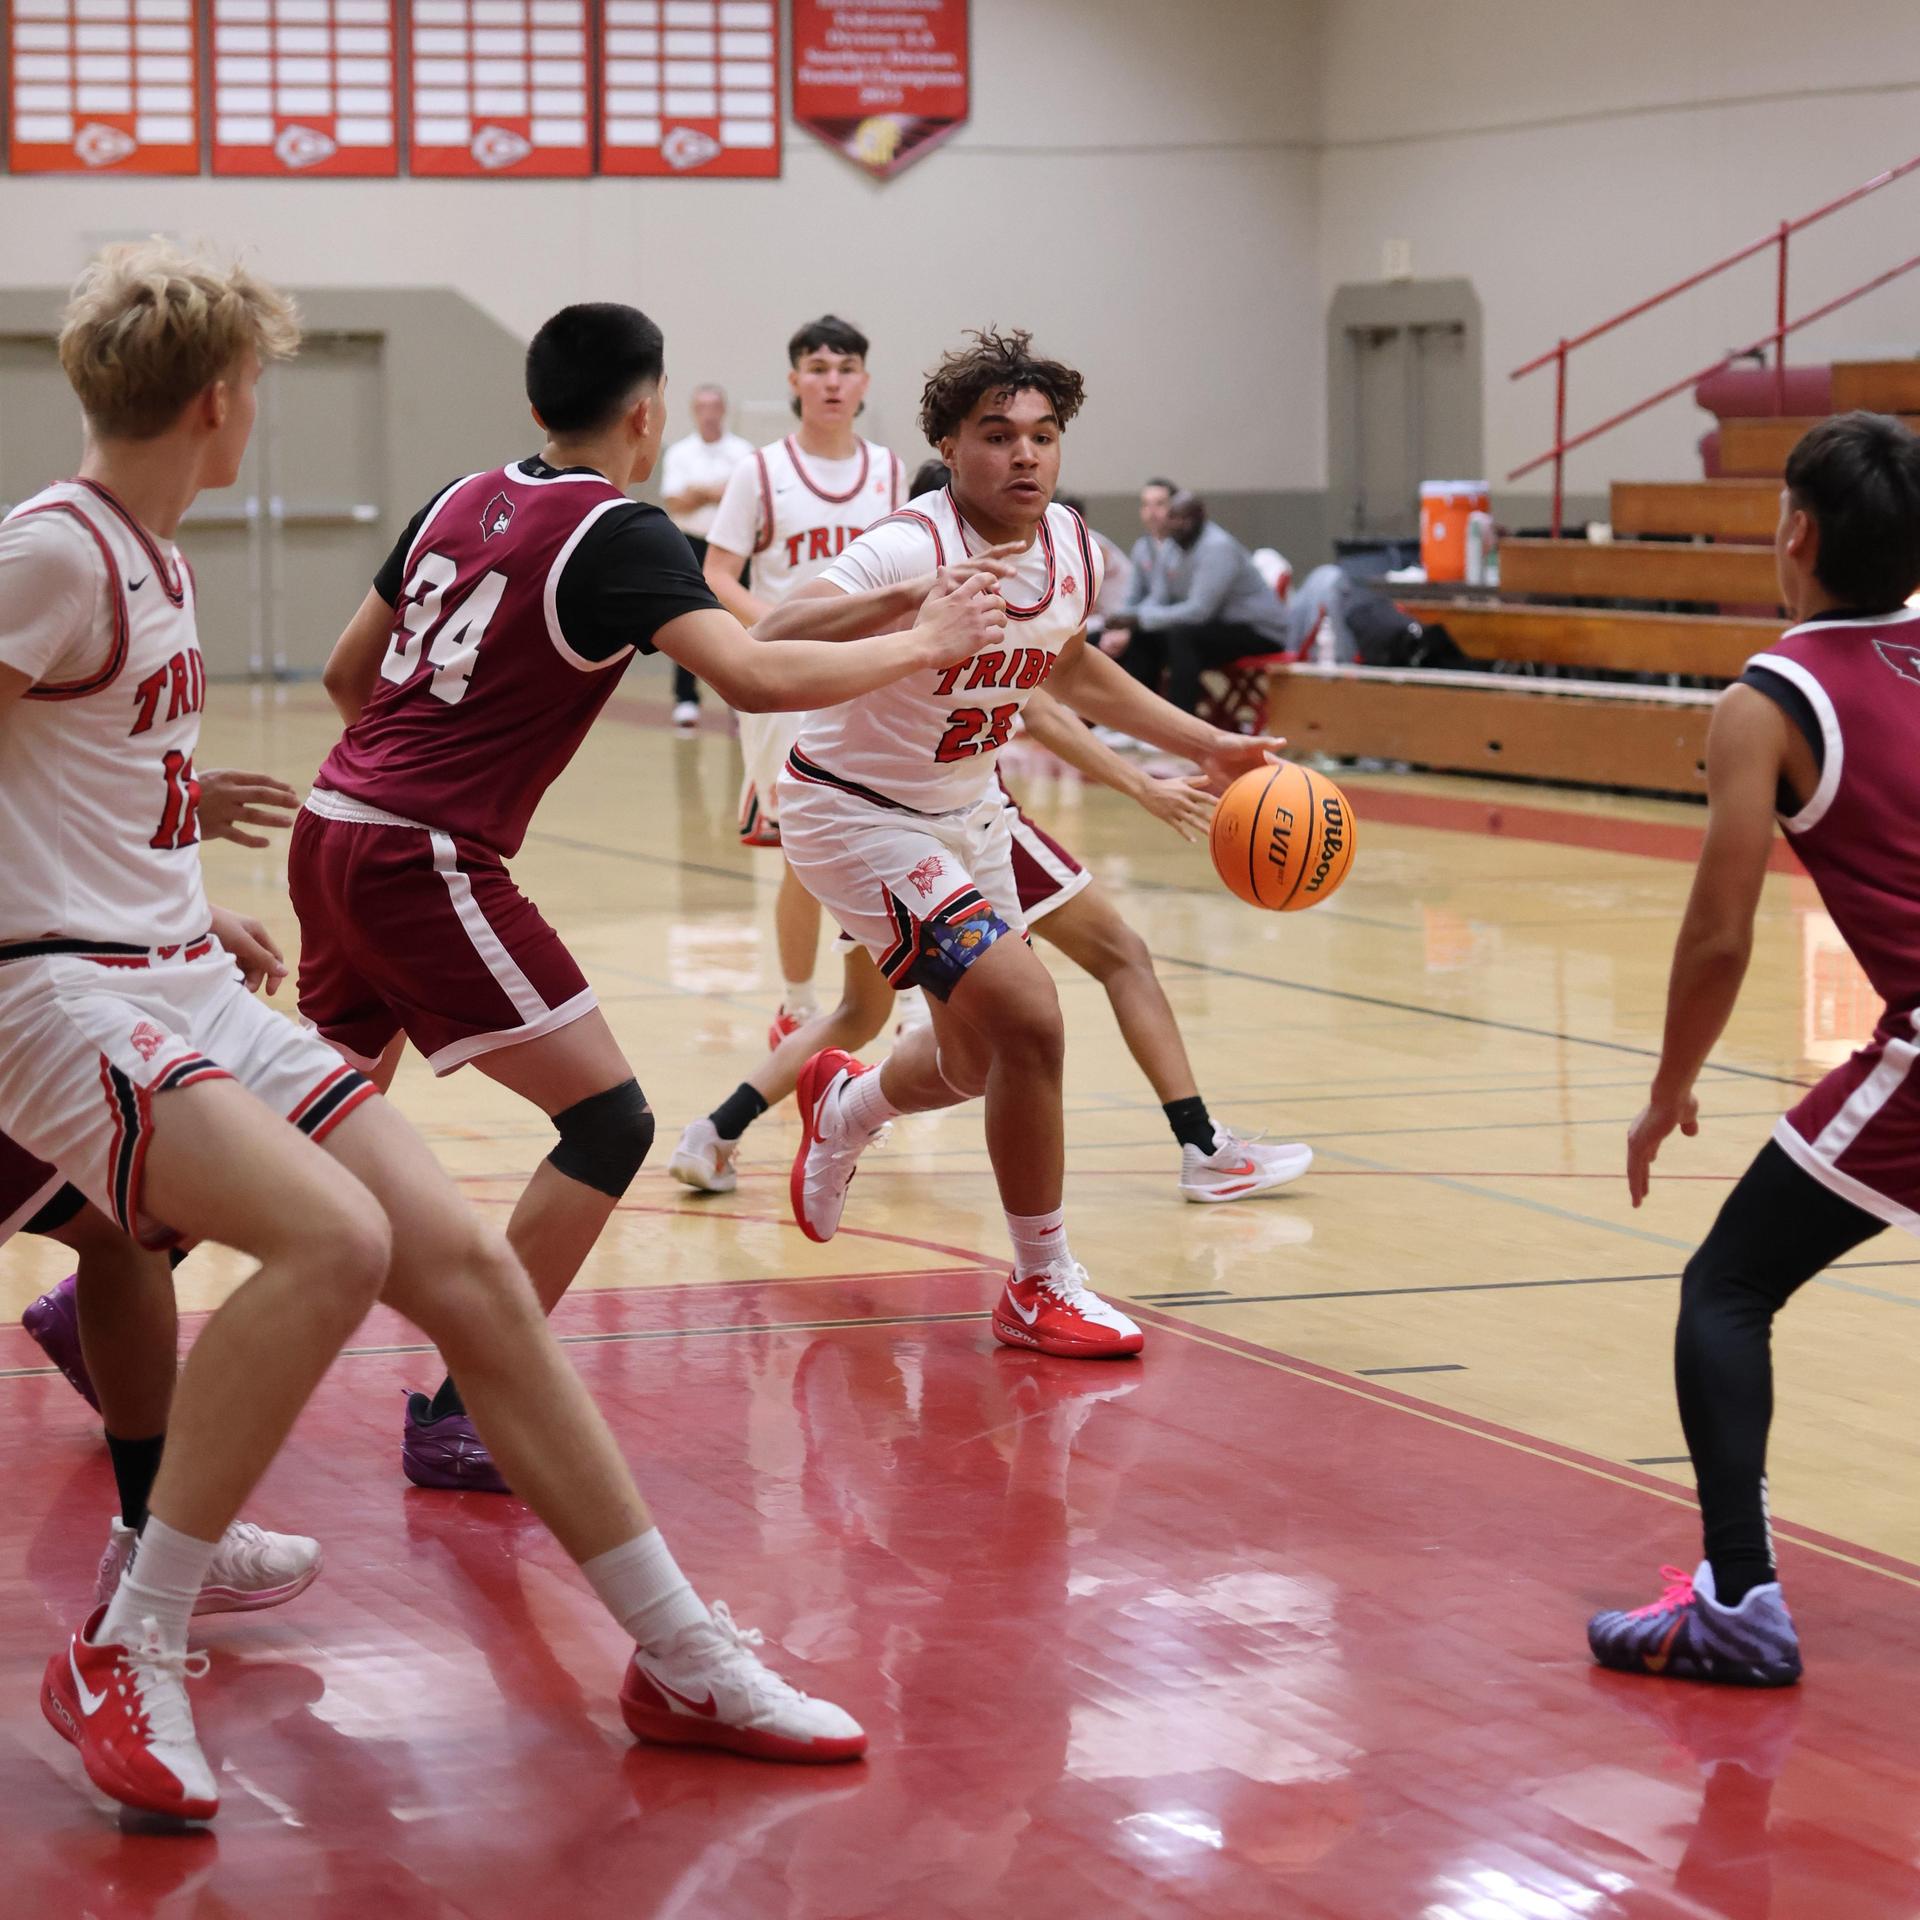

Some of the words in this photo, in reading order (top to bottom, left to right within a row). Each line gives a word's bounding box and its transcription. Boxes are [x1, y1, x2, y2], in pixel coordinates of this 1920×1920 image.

[380, 551, 508, 705] 34
[129, 648, 206, 737] TRI
[1268, 807, 1294, 867] EVO
[1305, 797, 1344, 893] Wilson
